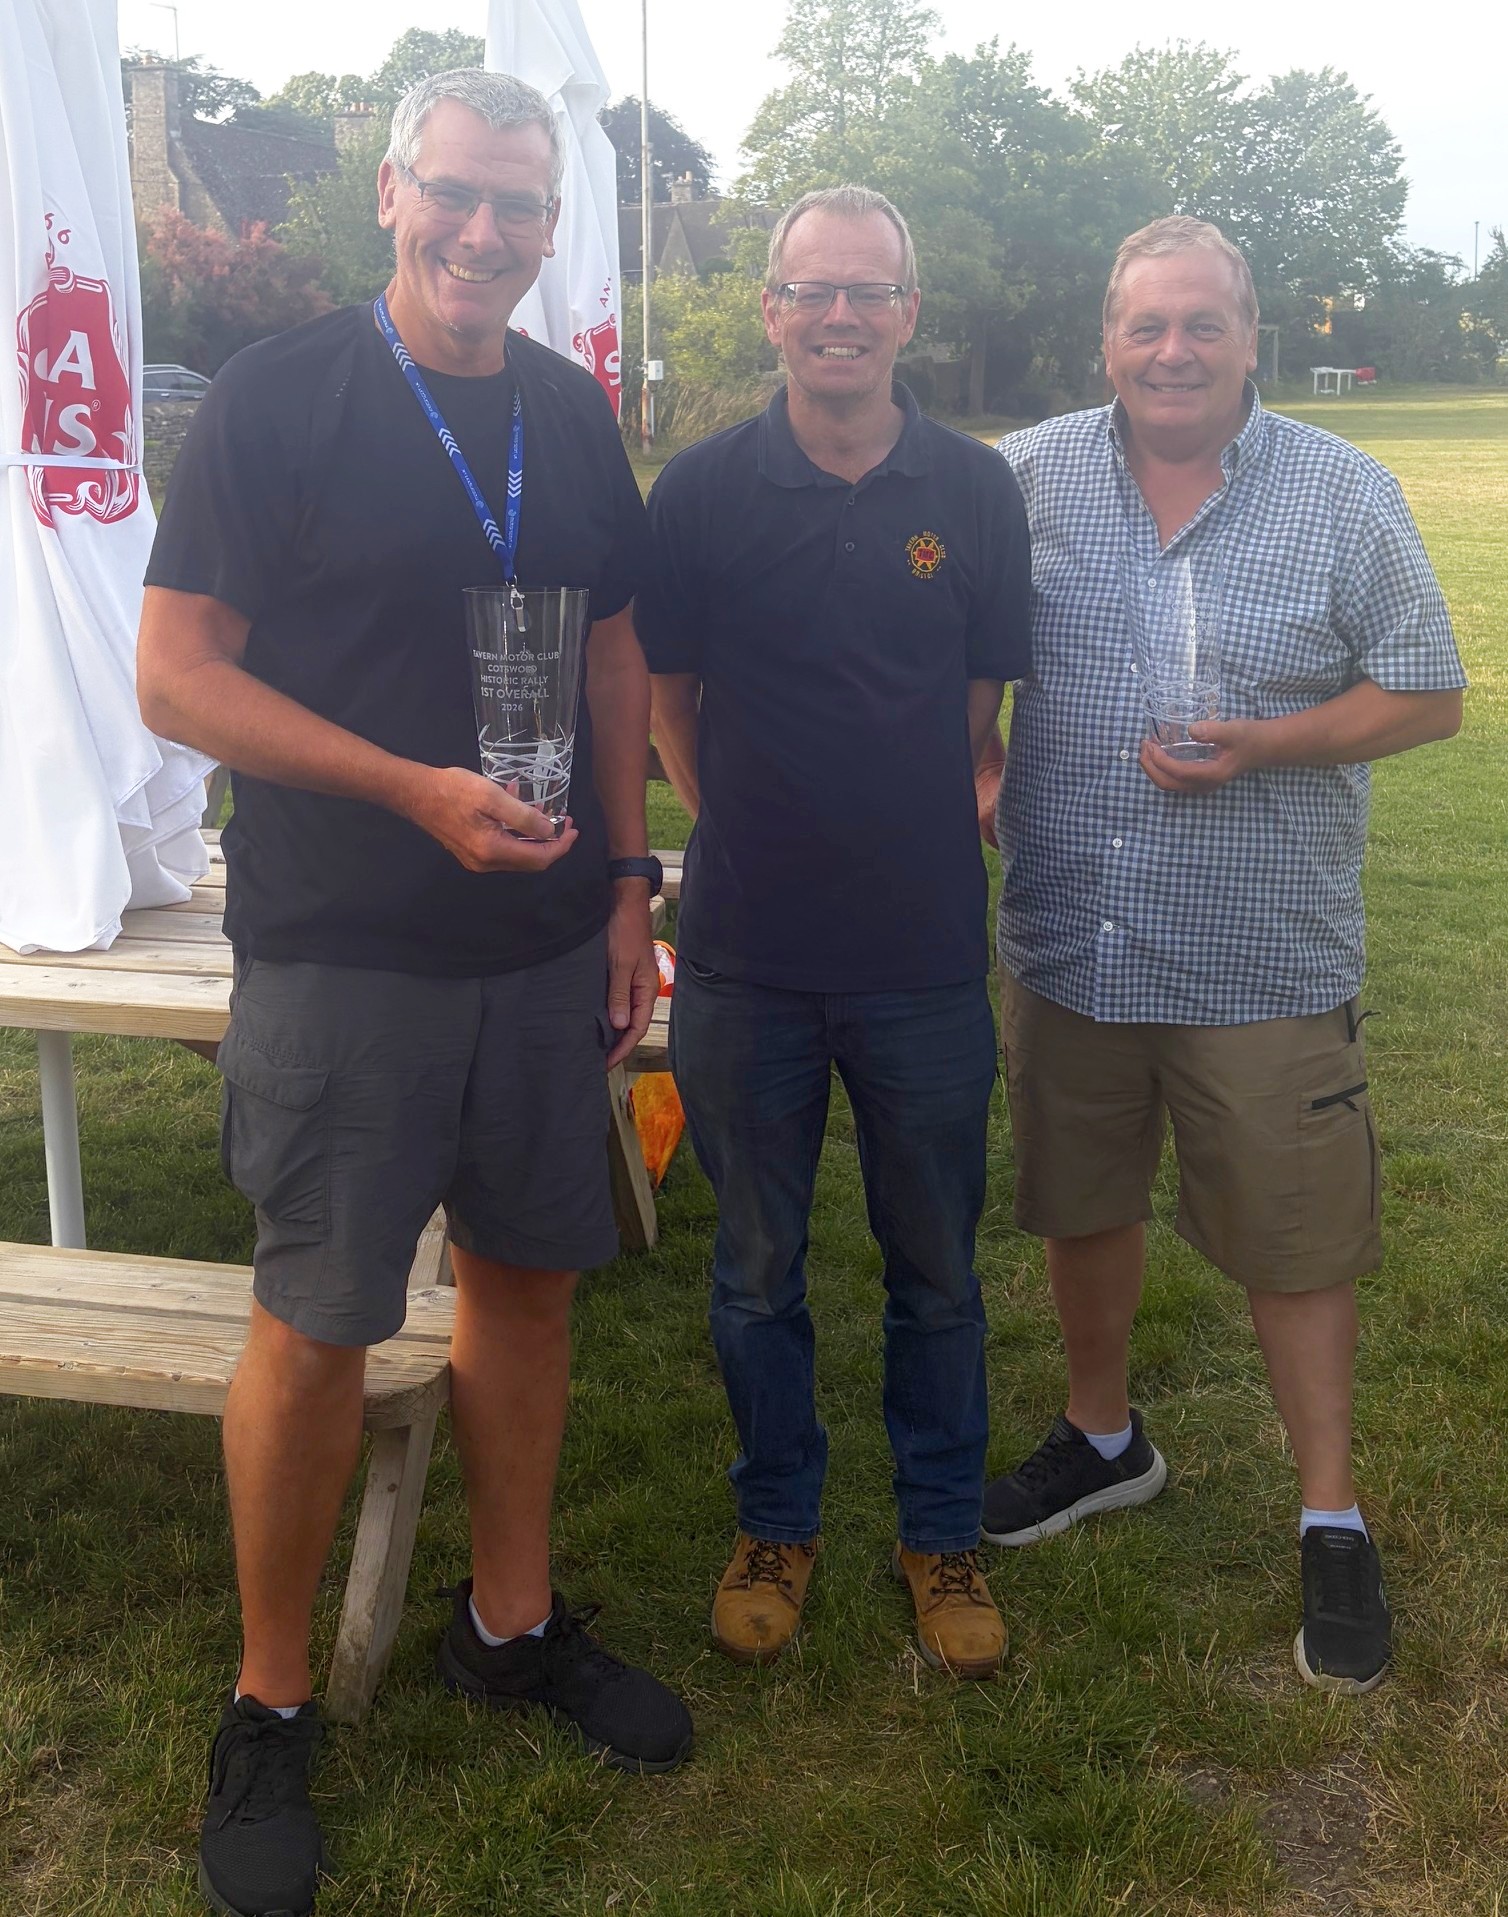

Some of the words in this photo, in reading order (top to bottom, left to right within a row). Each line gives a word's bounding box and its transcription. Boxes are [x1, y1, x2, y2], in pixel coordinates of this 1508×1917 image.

[473, 649, 498, 660] TAVERN
[500, 653, 535, 661] MOTOR
[536, 651, 560, 661] CLUB
[480, 674, 519, 685] HISTORIC
[520, 675, 549, 685] RALLY
[480, 686, 494, 698] 1ST
[496, 688, 550, 699] OVERALL
[501, 703, 523, 712] 2026
